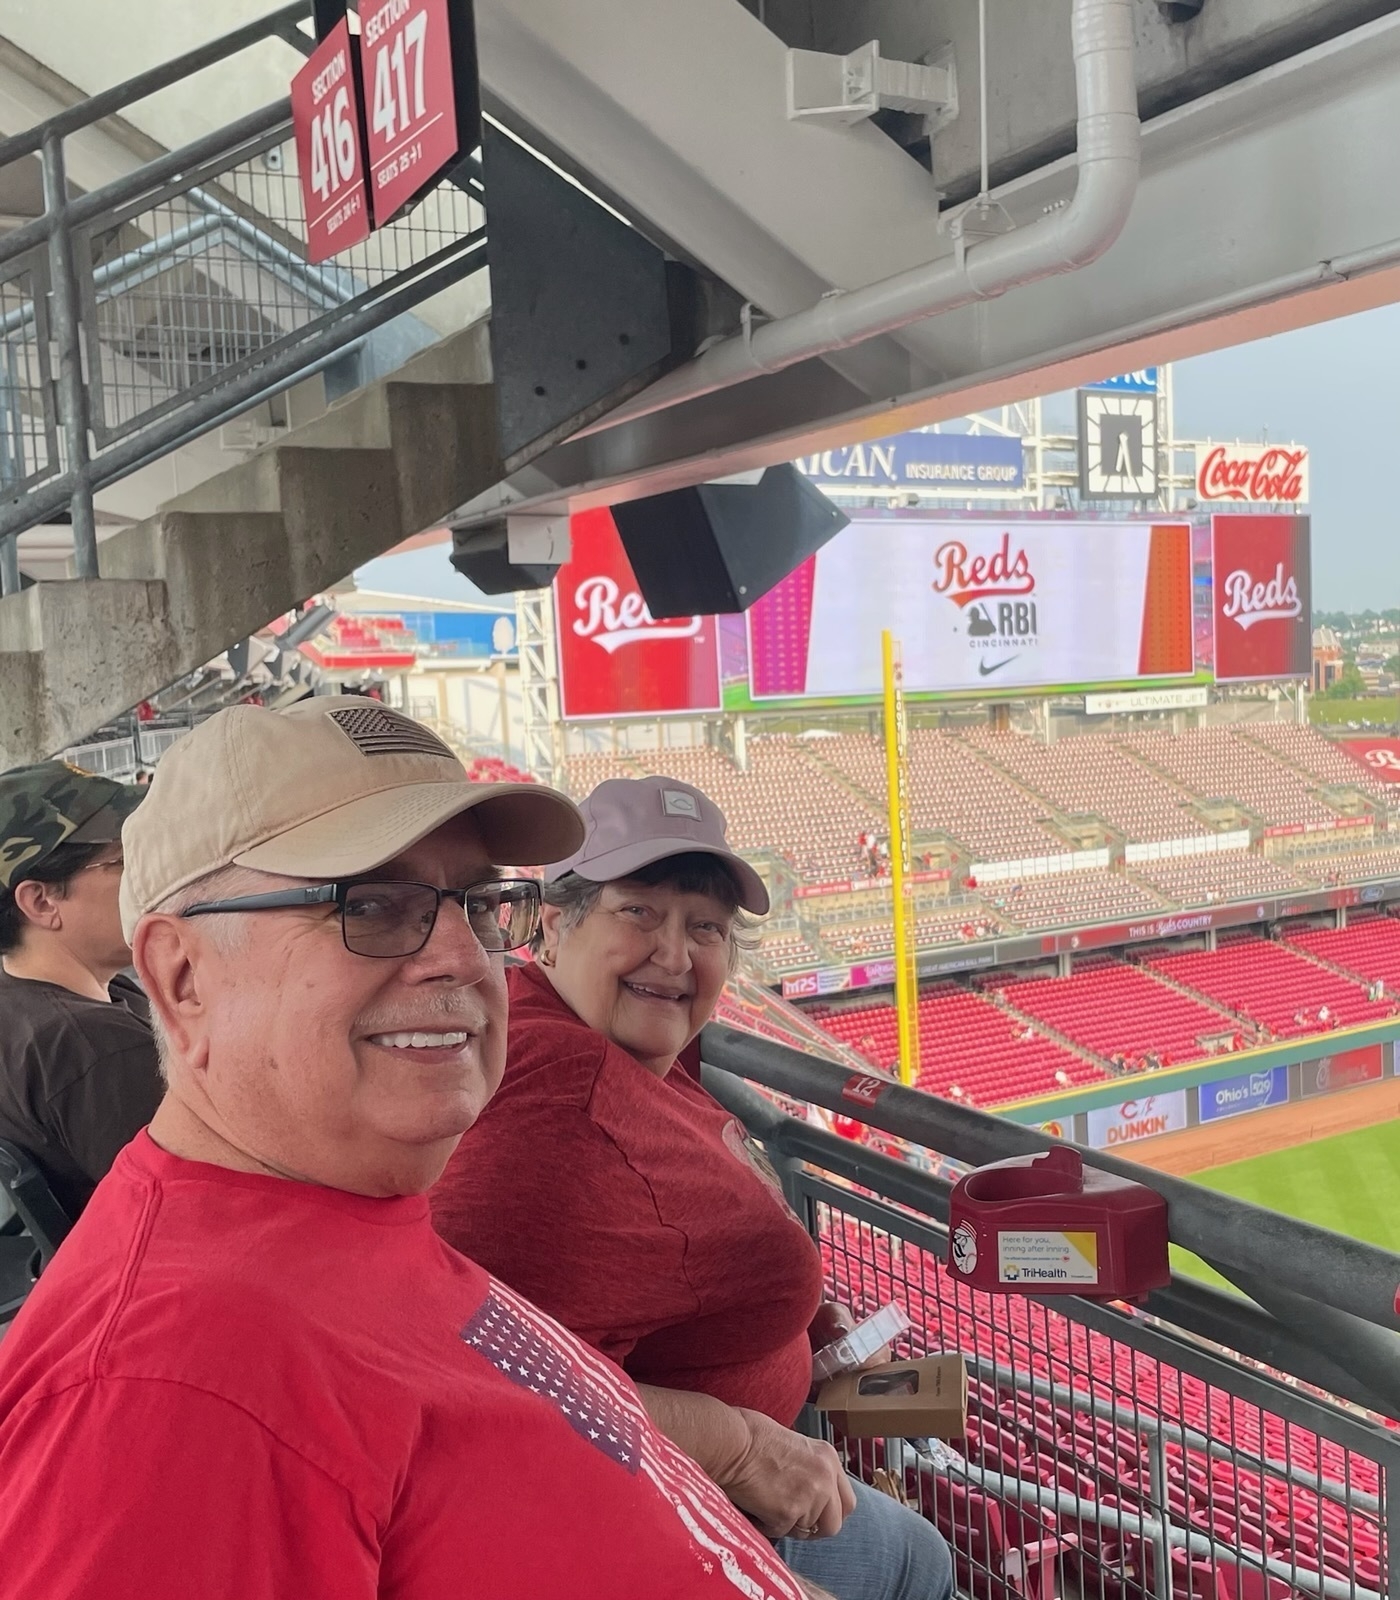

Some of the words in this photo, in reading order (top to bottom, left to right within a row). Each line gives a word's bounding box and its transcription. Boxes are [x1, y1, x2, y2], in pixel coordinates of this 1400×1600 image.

[365, 0, 411, 48] SECTION
[311, 49, 347, 105] SECTION
[372, 9, 428, 144] 417
[310, 86, 356, 202] 416
[906, 463, 975, 481] INSURANCE
[977, 465, 1019, 482] GROUP
[1199, 445, 1308, 502] Coca-Cola
[933, 532, 1036, 609] Reds
[1222, 562, 1303, 630] Reds
[998, 601, 1038, 637] RBI
[969, 638, 1039, 649] CINCINNATI
[1130, 694, 1182, 707] ULTIMATE
[1129, 925, 1146, 938] THIS
[1177, 915, 1213, 931] COUNTRY
[852, 1076, 881, 1097] 12
[1215, 1084, 1249, 1105] Ohio's
[1002, 1236, 1021, 1244] Here
[1022, 1236, 1034, 1244] for
[1002, 1245, 1027, 1254] inning
[1027, 1244, 1045, 1253] after
[1046, 1245, 1070, 1255] inning
[1021, 1267, 1068, 1279] TriHealth
